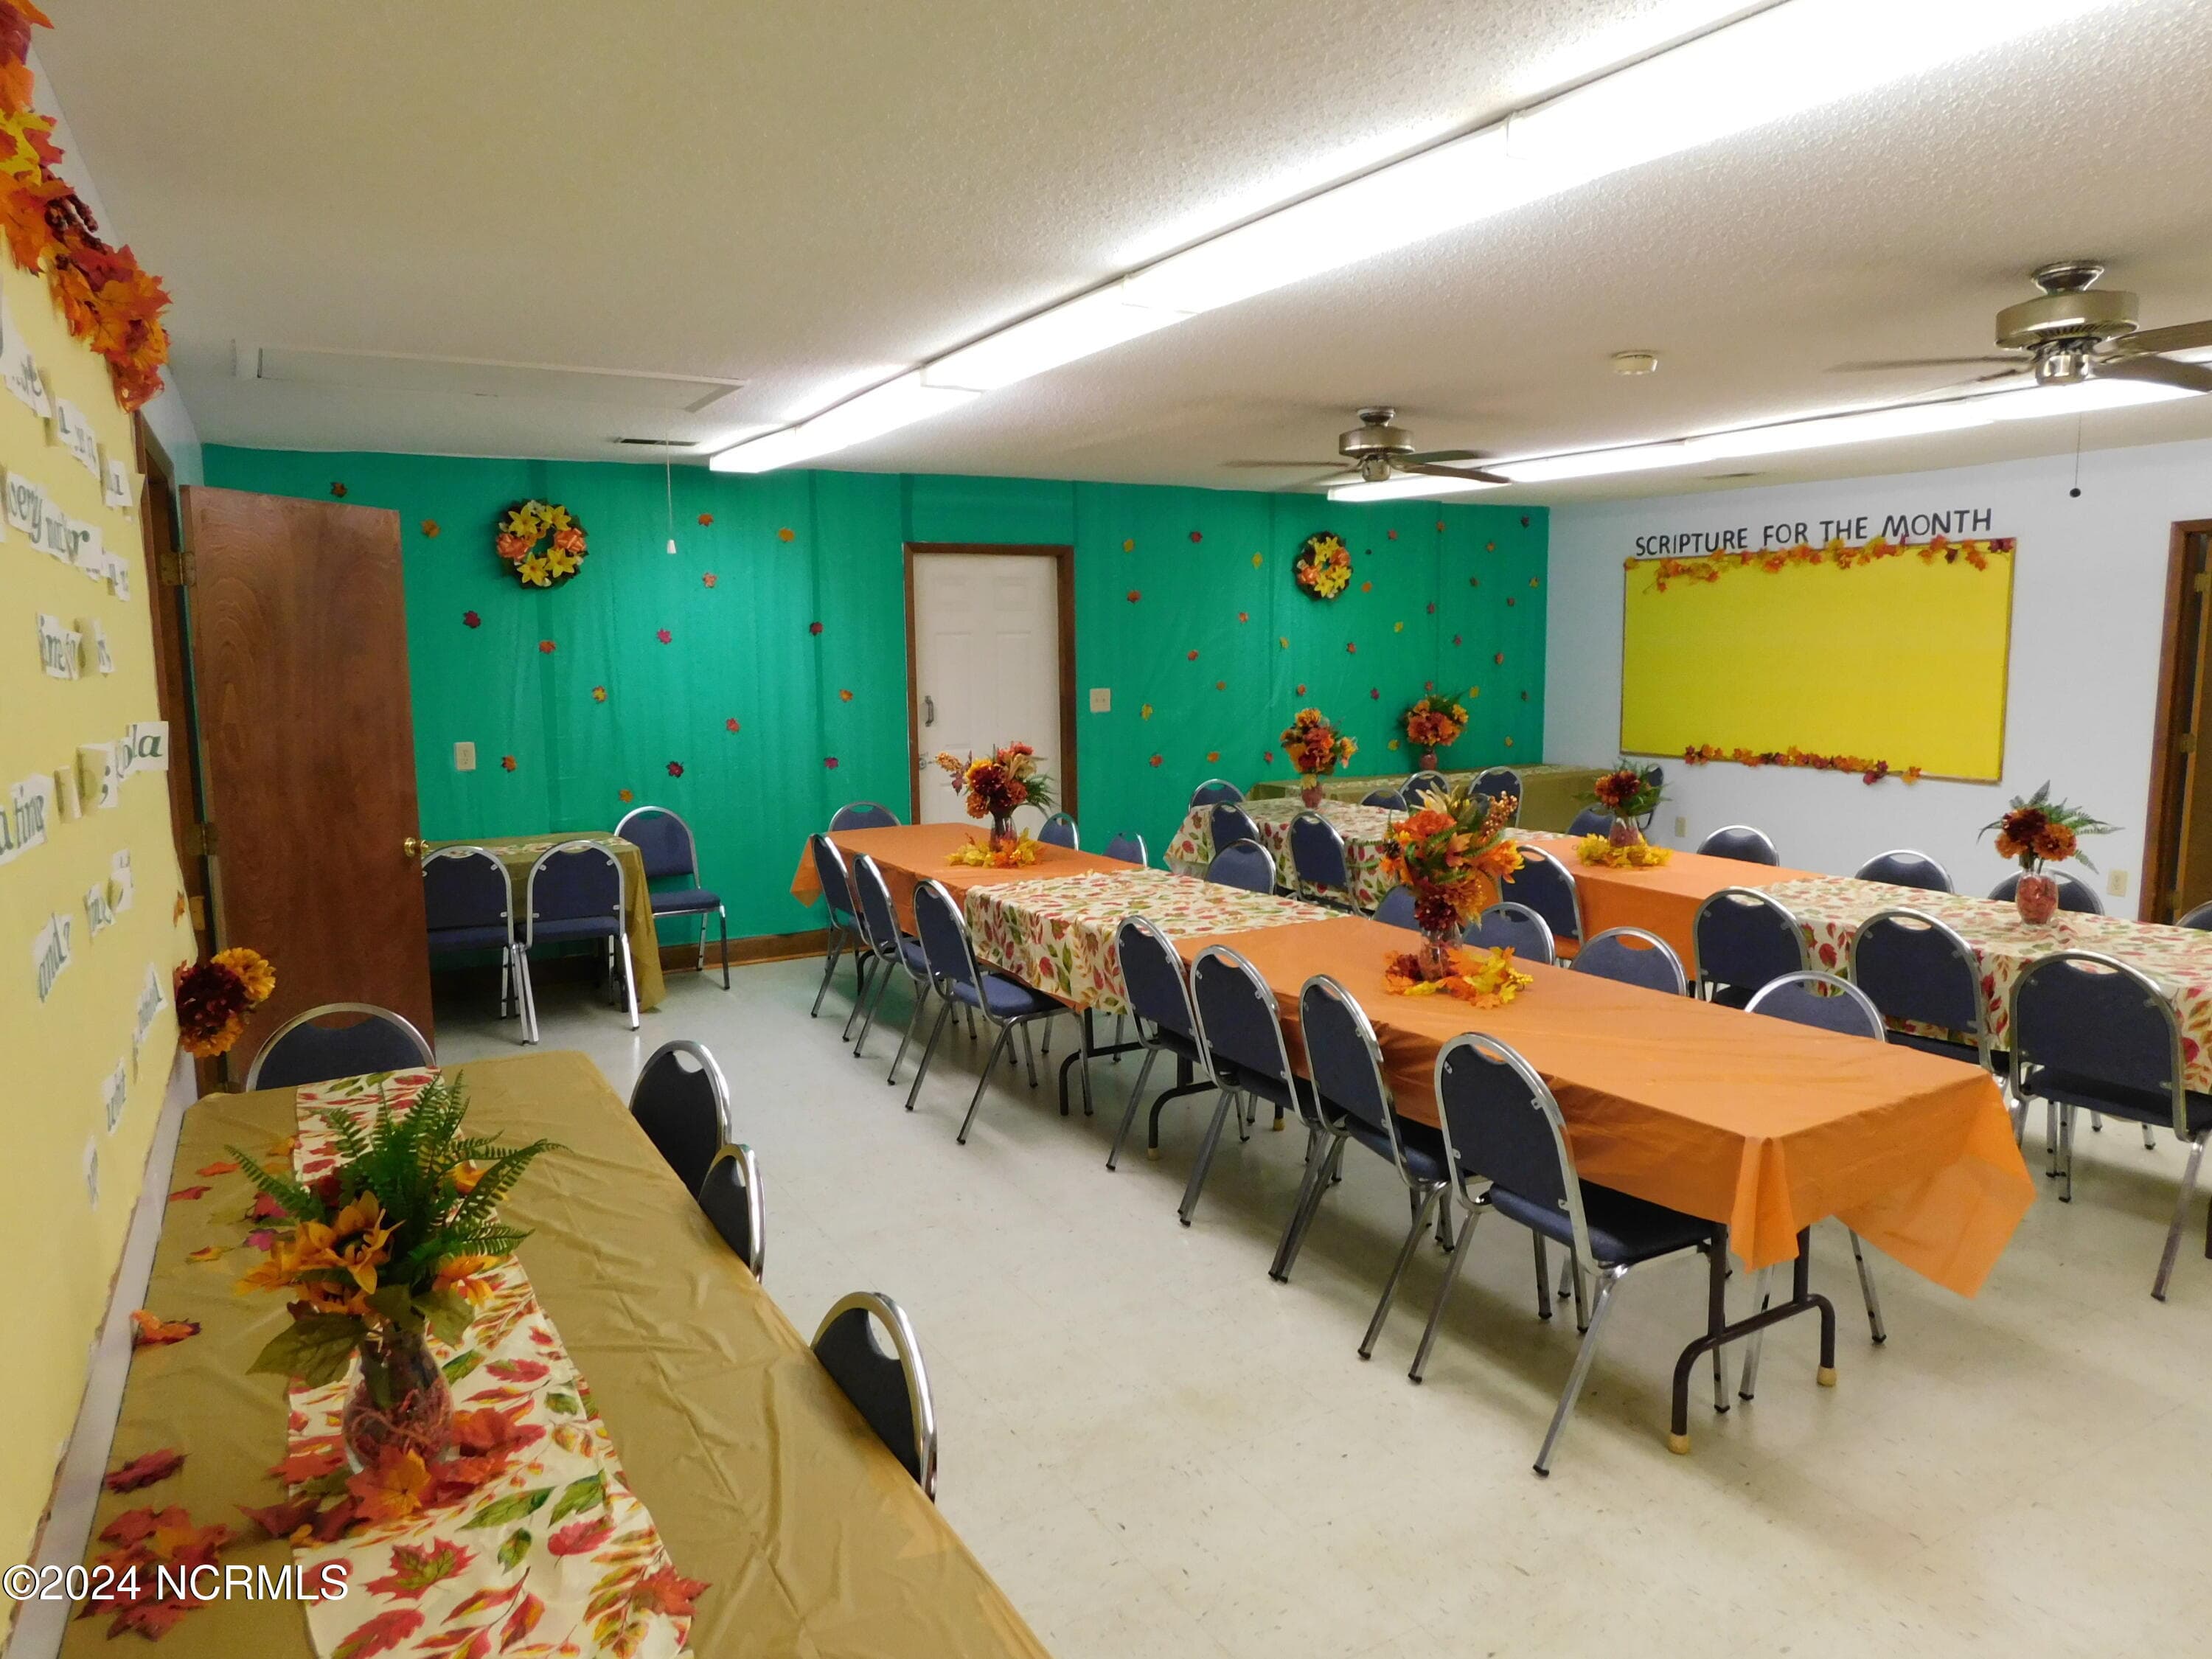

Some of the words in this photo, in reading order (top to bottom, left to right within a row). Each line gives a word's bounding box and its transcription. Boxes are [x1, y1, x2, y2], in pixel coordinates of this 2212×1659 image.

[1635, 527, 1748, 557] SCRIPTURE
[1762, 522, 1809, 547] FOR
[1819, 517, 1868, 542] THE
[1881, 508, 1992, 538] MONTH
